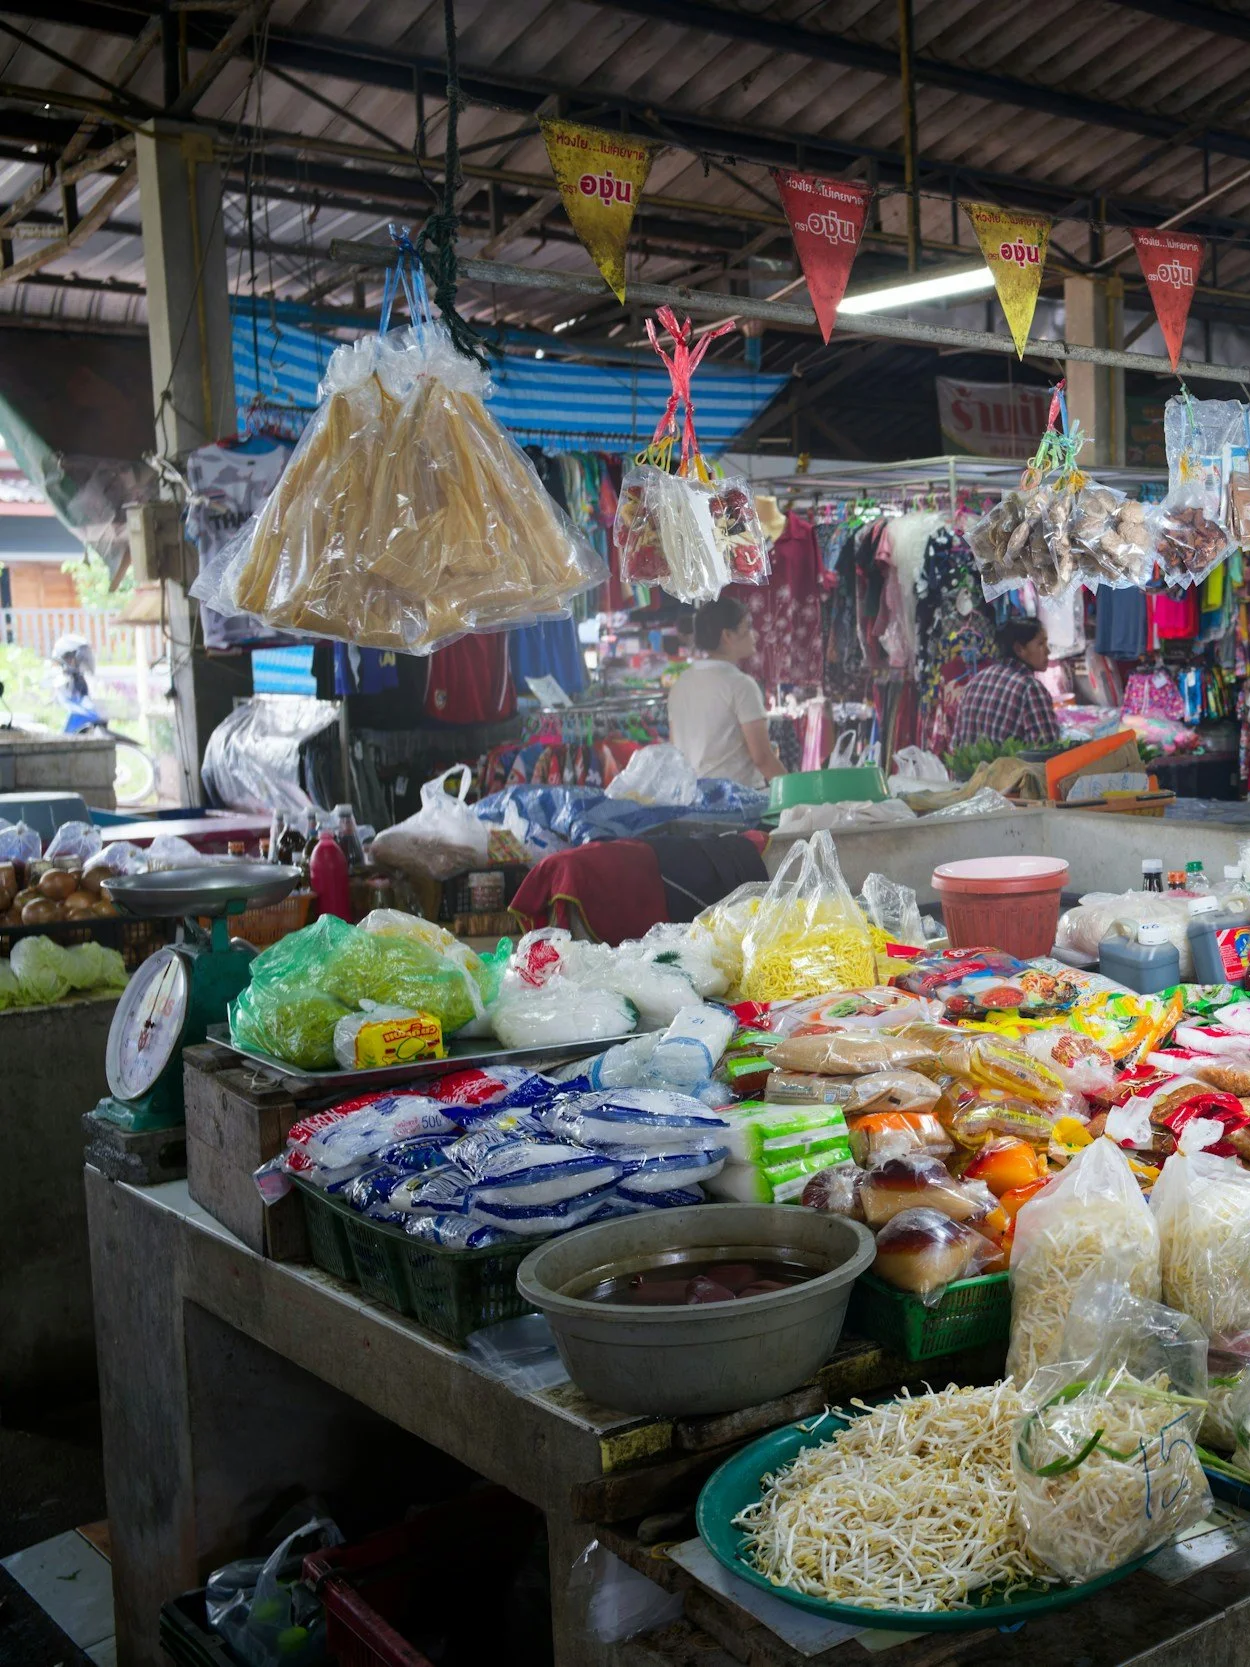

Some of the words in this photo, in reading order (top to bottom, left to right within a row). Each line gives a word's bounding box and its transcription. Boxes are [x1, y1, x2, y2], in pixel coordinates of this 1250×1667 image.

[579, 168, 634, 207] องุ่น
[807, 210, 856, 245] องุ่น
[1000, 237, 1040, 268] องุ่น
[1157, 259, 1194, 289] องุ่น
[1139, 1411, 1193, 1520] 15
